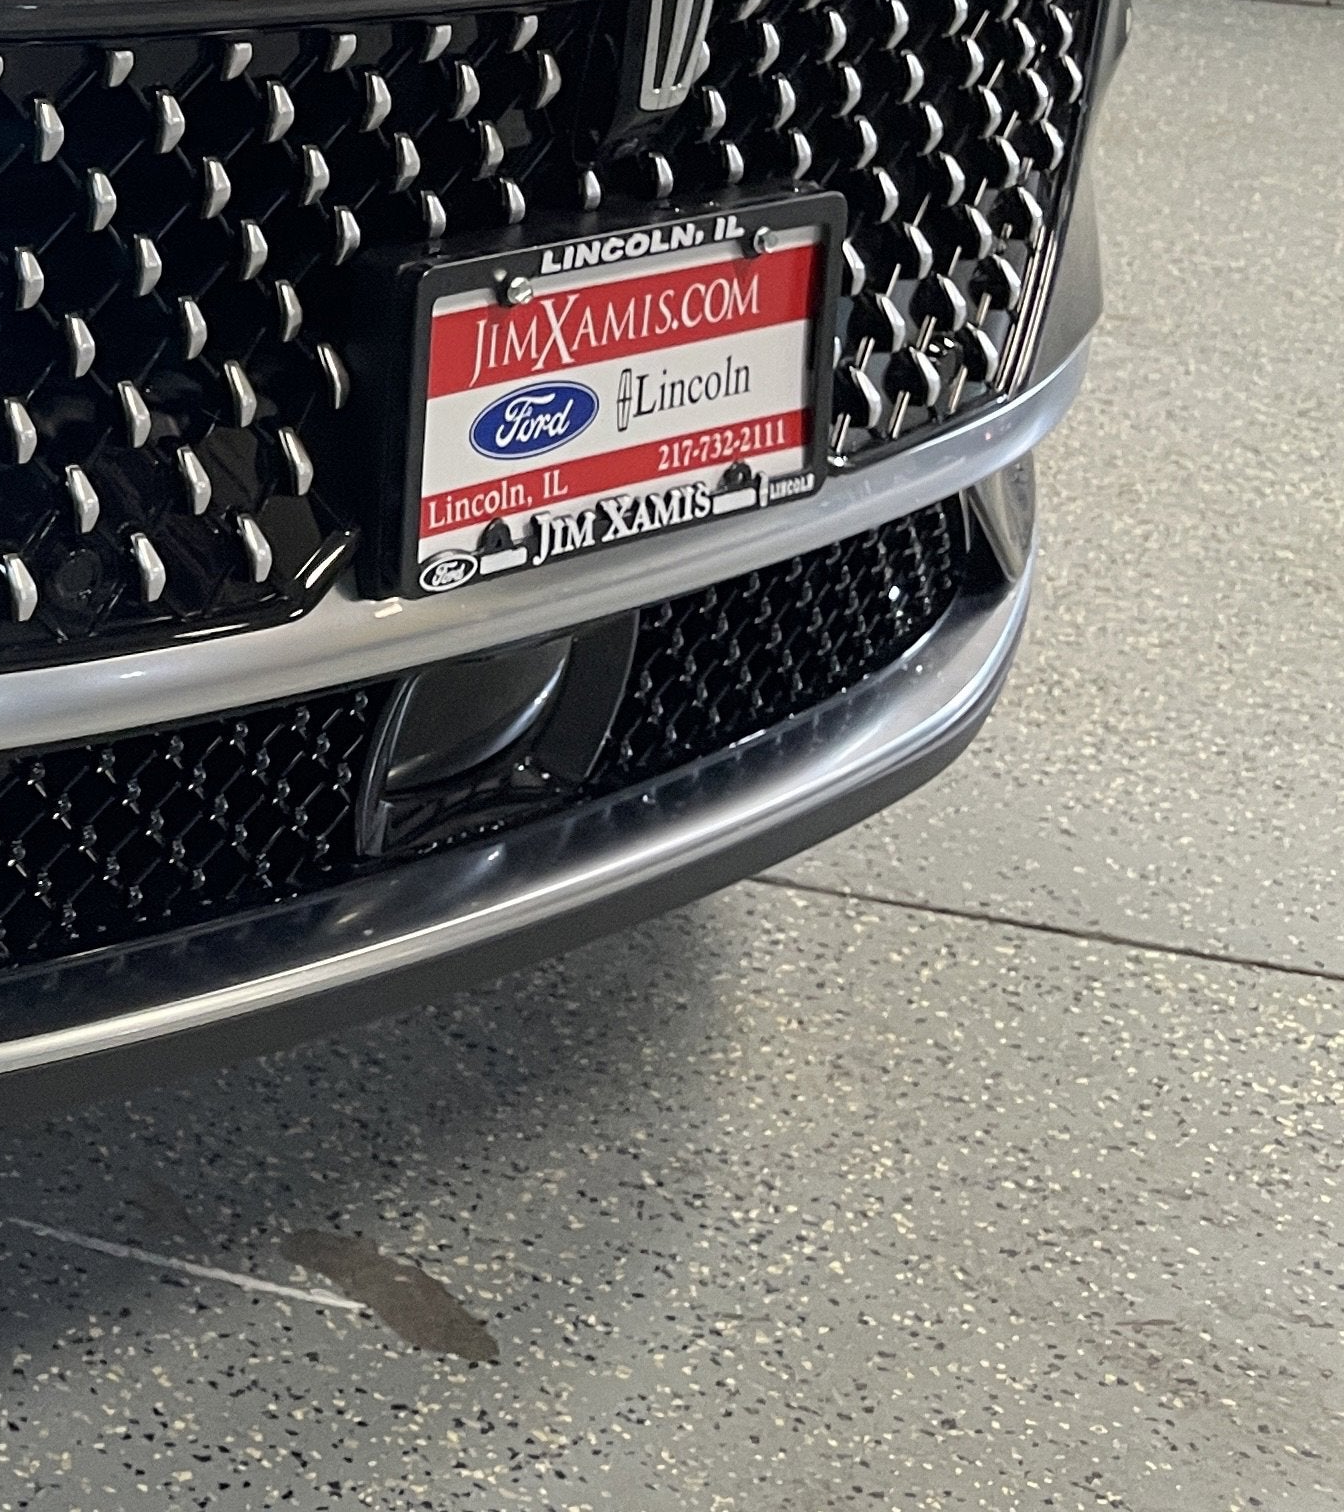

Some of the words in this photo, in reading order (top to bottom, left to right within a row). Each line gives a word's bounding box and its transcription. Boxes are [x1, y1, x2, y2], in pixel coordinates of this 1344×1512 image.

[541, 223, 705, 275] LINCOLN,
[714, 215, 745, 241] IL
[495, 391, 571, 447] Ford
[632, 355, 750, 418] Lincoln
[657, 419, 786, 472] 217-732-2111
[428, 479, 534, 530] Lincoln,
[544, 470, 569, 497] IL
[532, 512, 595, 567] JIM
[601, 483, 712, 543] XAMIS
